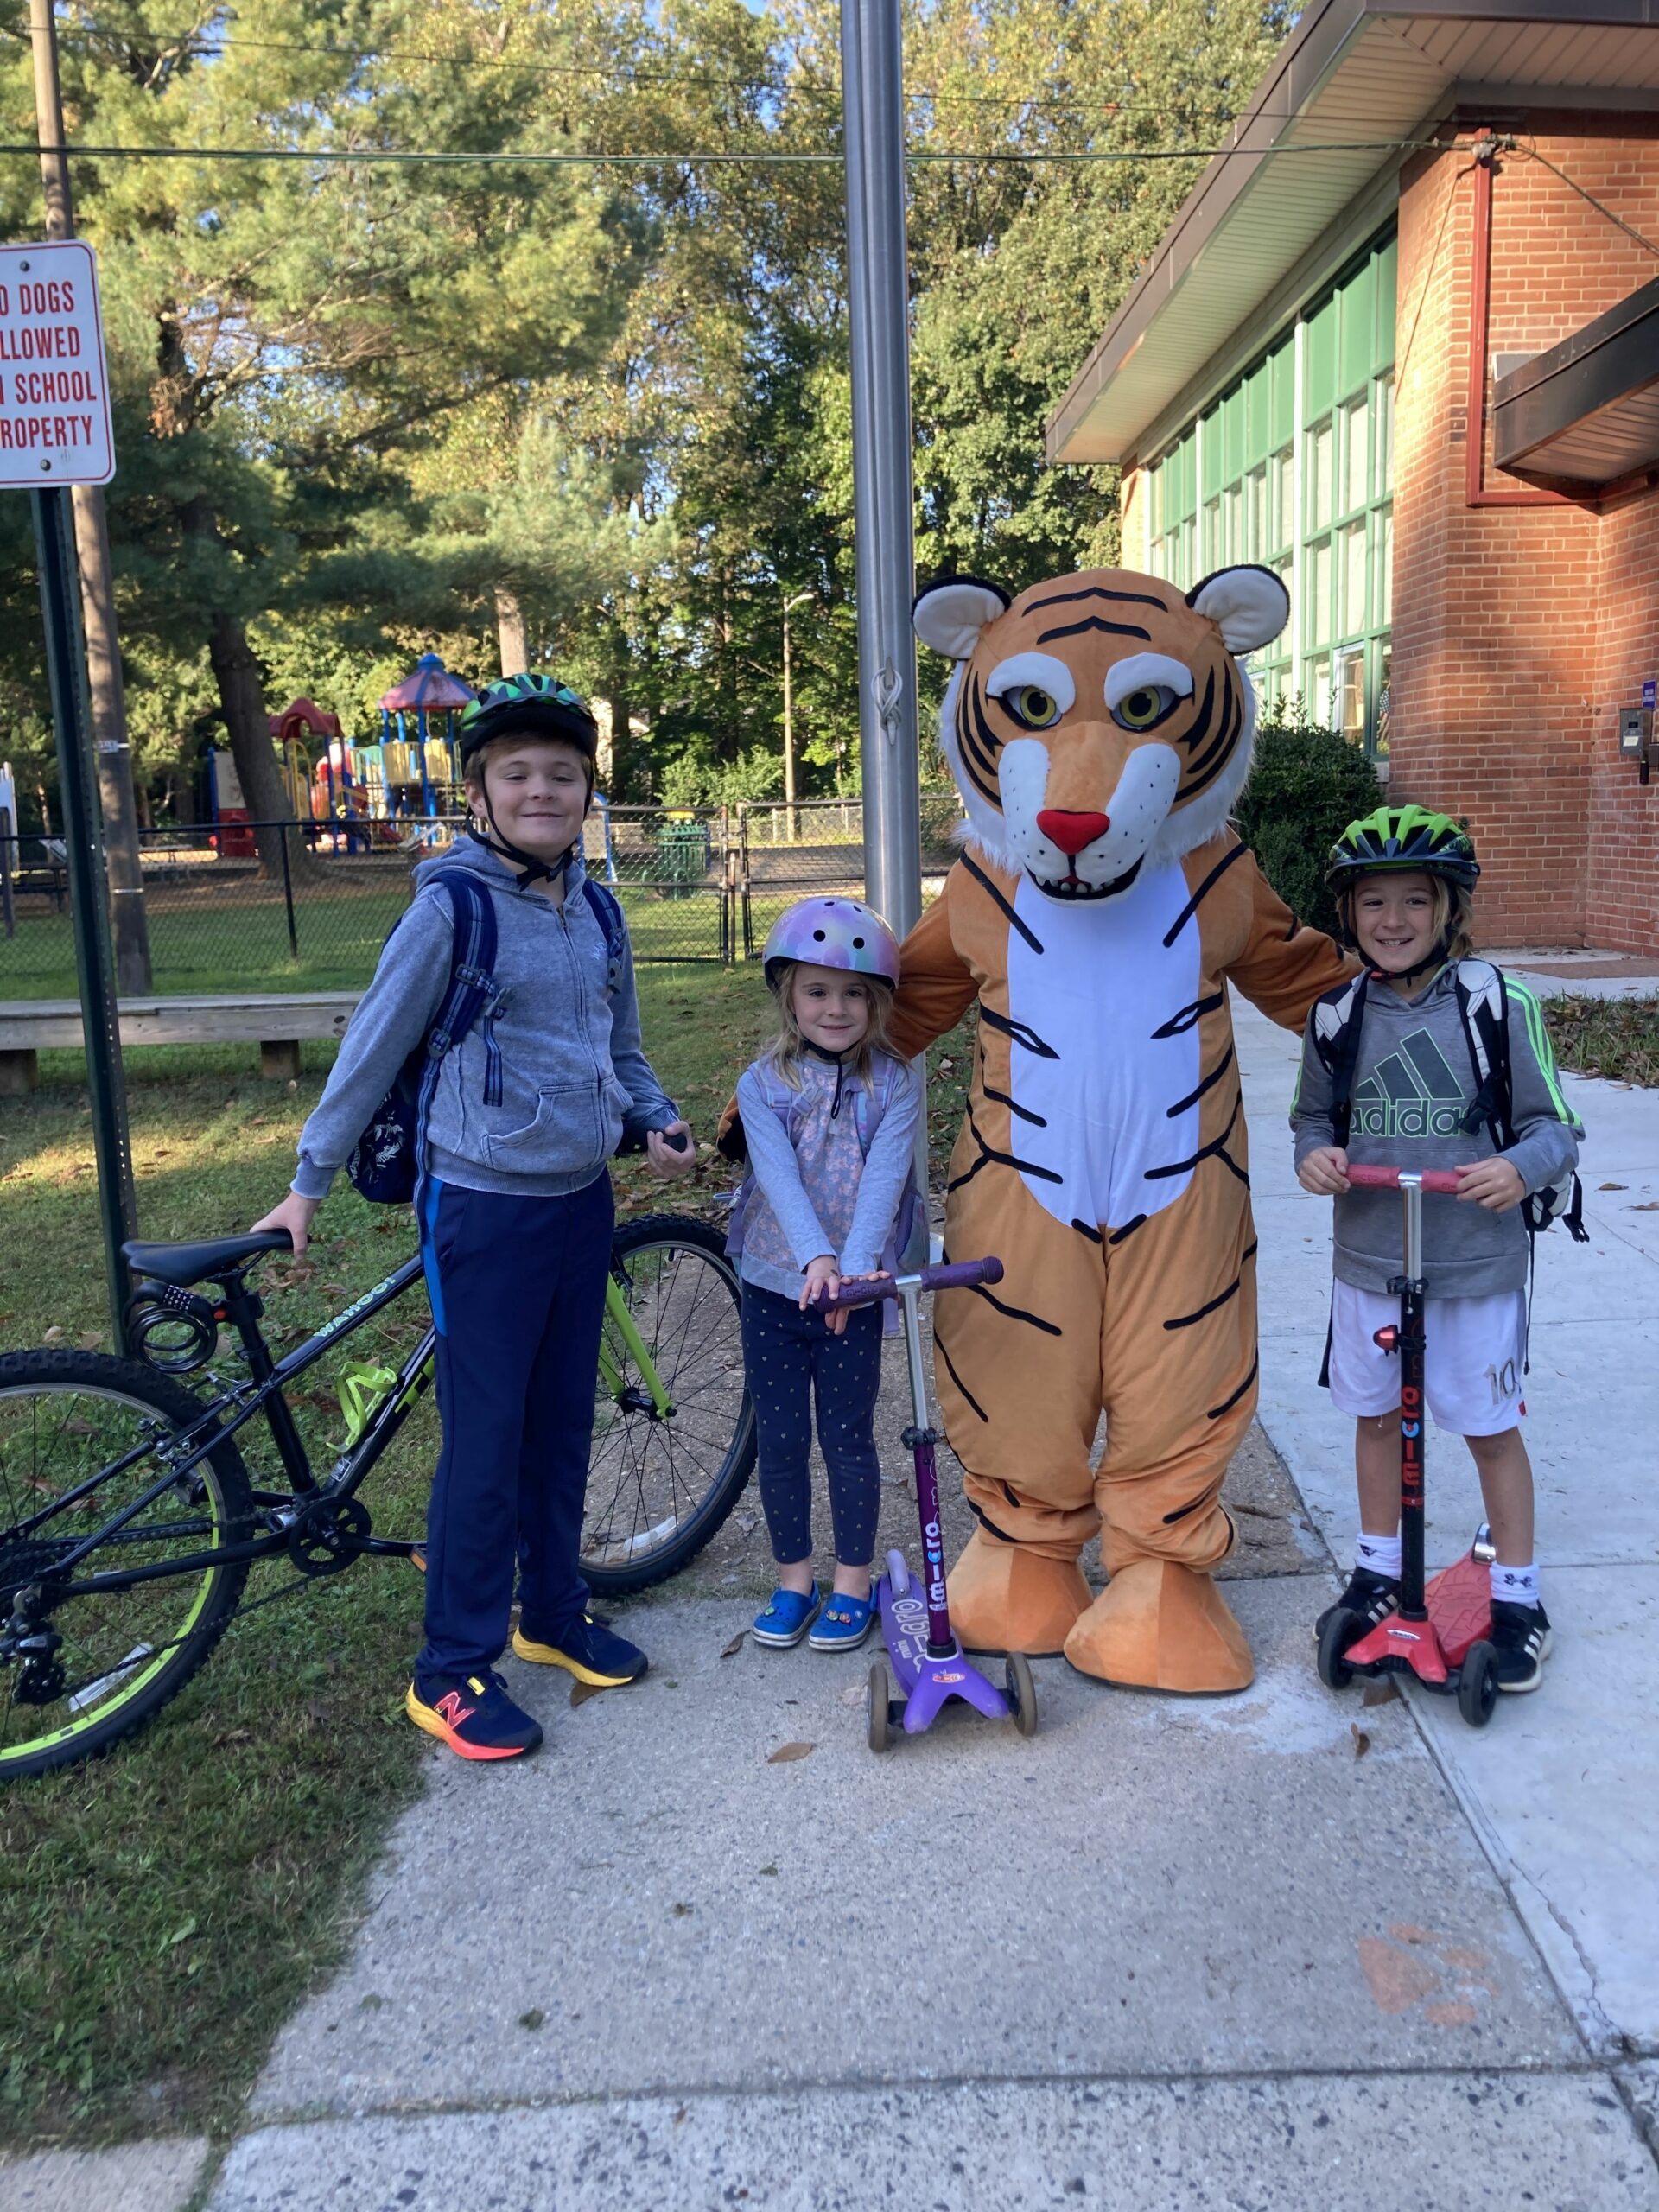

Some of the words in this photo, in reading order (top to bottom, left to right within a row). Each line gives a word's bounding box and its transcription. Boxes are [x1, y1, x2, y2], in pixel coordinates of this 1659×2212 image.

[0, 283, 9, 316] O
[19, 281, 75, 315] DOGS
[0, 326, 81, 360] LLOWED
[15, 371, 97, 404] SCHOOL
[0, 416, 92, 448] ROPERTY
